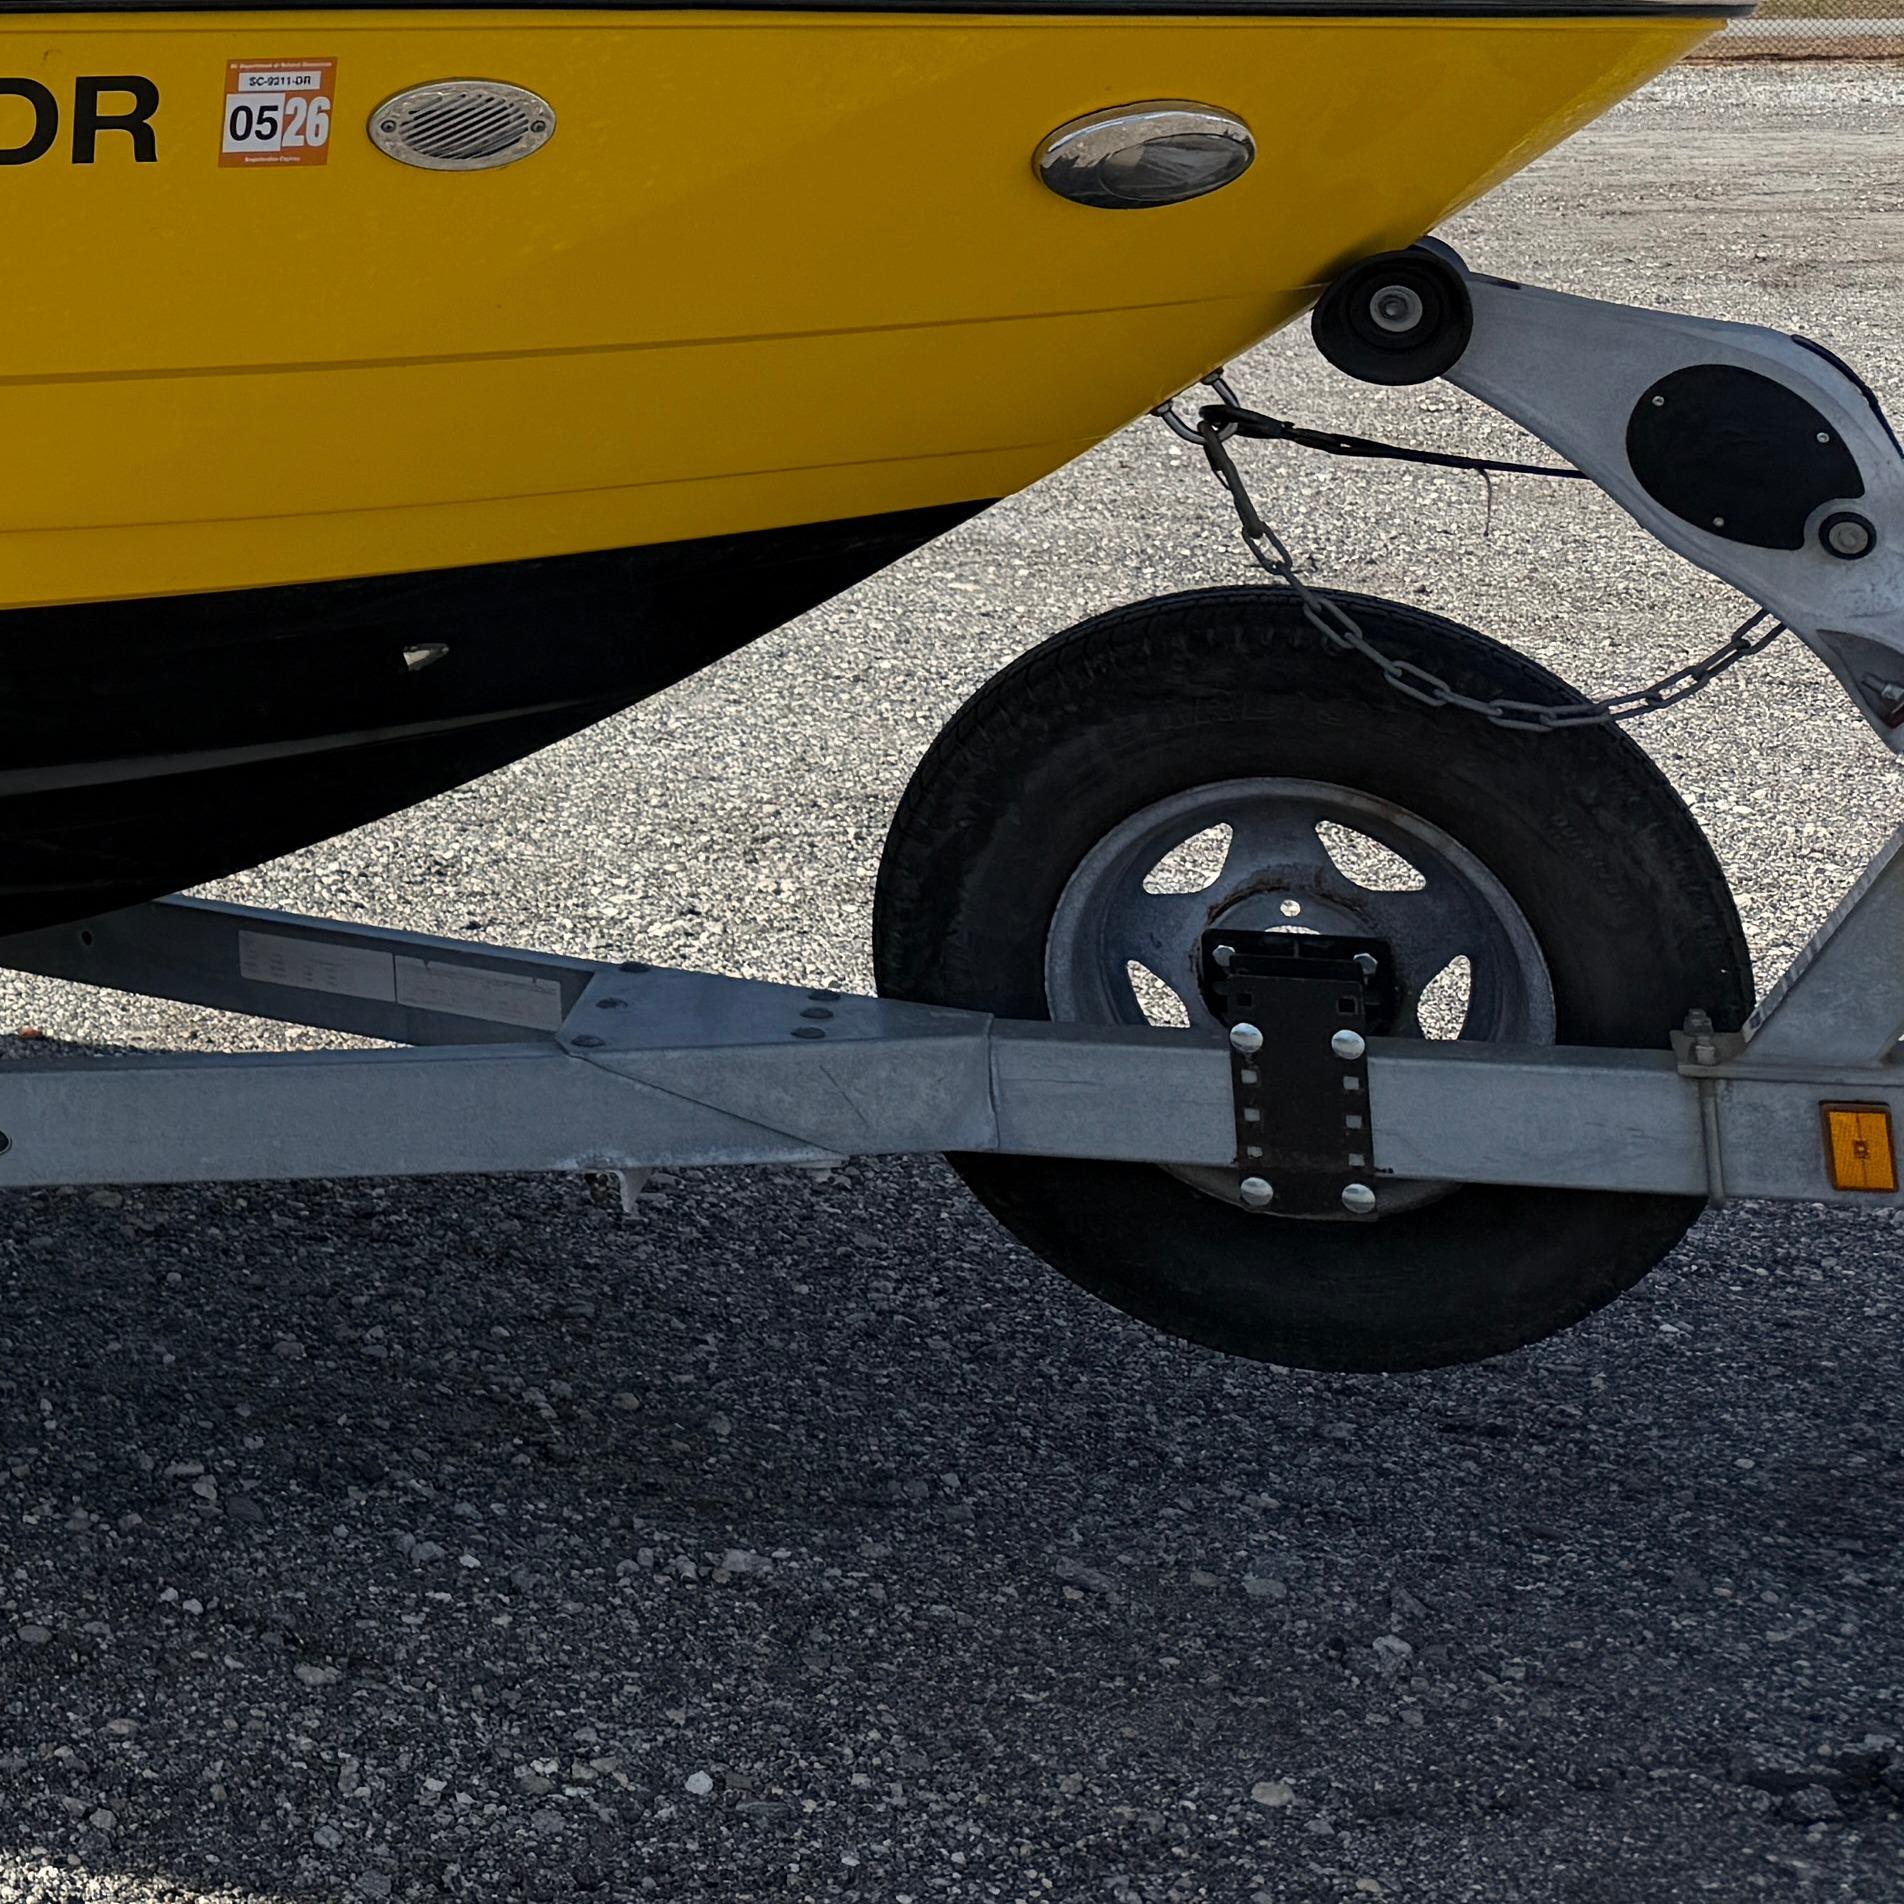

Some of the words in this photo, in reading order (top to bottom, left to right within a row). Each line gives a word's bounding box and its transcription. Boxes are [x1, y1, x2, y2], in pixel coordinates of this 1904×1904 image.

[249, 75, 312, 87] SC-9211-DR
[229, 105, 279, 141] 05
[282, 96, 332, 147] 26
